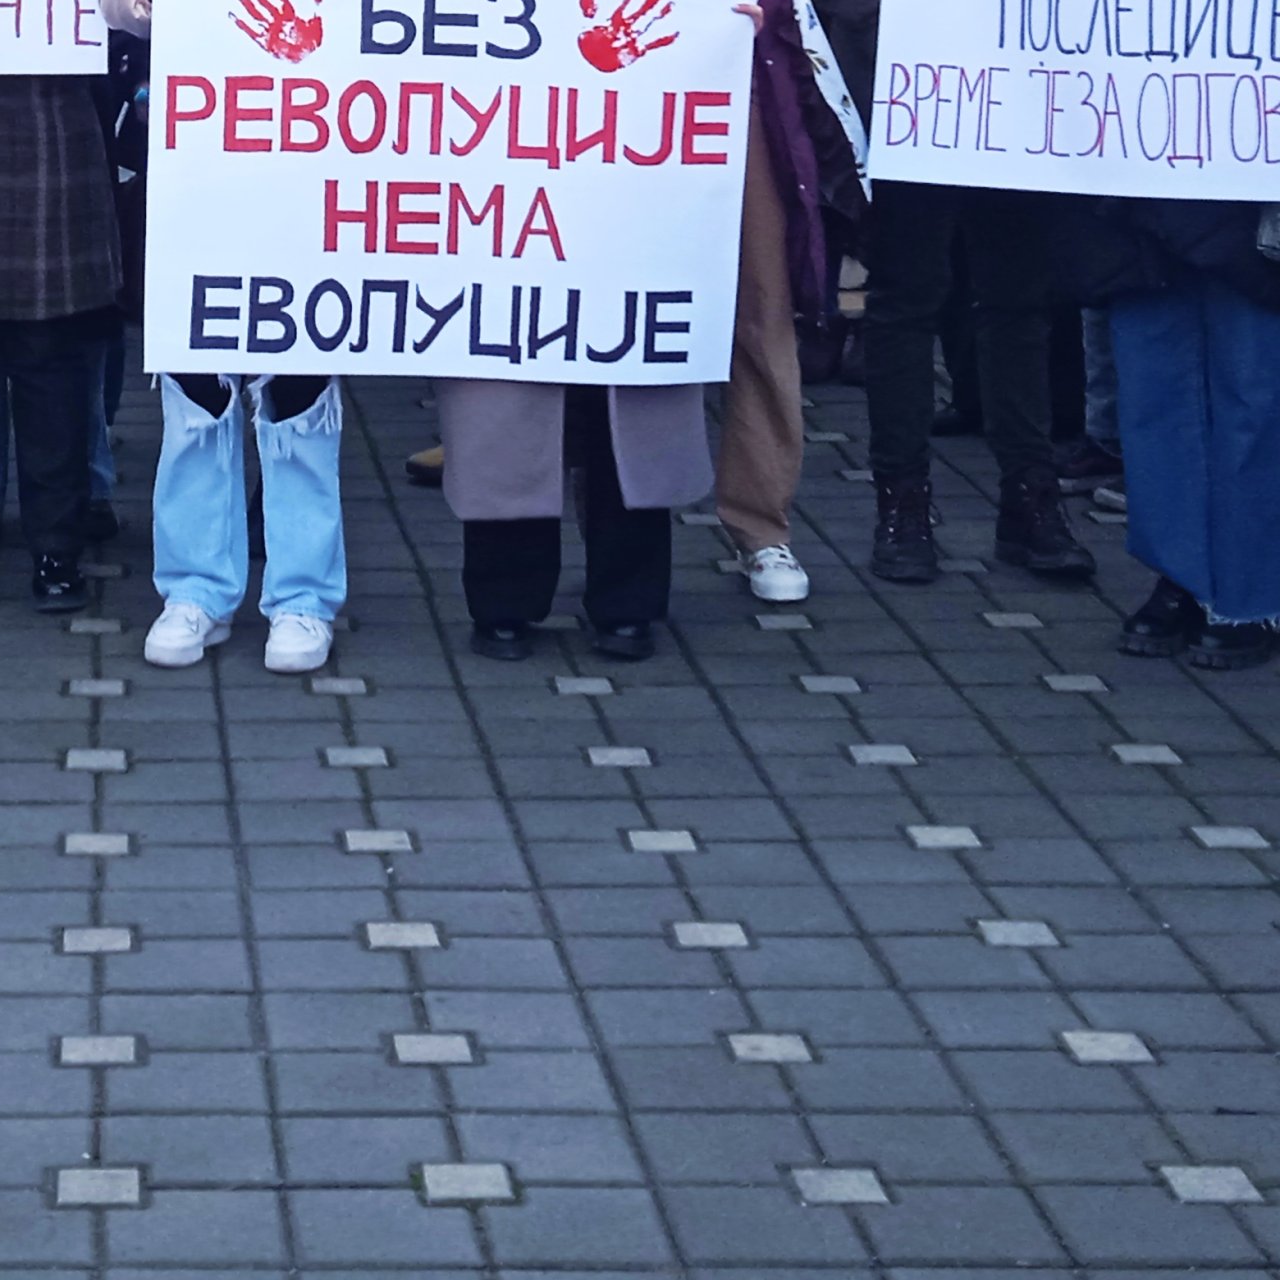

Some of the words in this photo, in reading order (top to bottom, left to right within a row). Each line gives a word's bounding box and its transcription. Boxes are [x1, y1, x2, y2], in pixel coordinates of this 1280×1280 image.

[165, 75, 732, 171] РЕВОЛУЦИЈЕ
[323, 179, 566, 263] НЕМА
[189, 274, 694, 365] ЕВОЛУЦИЈЕ
